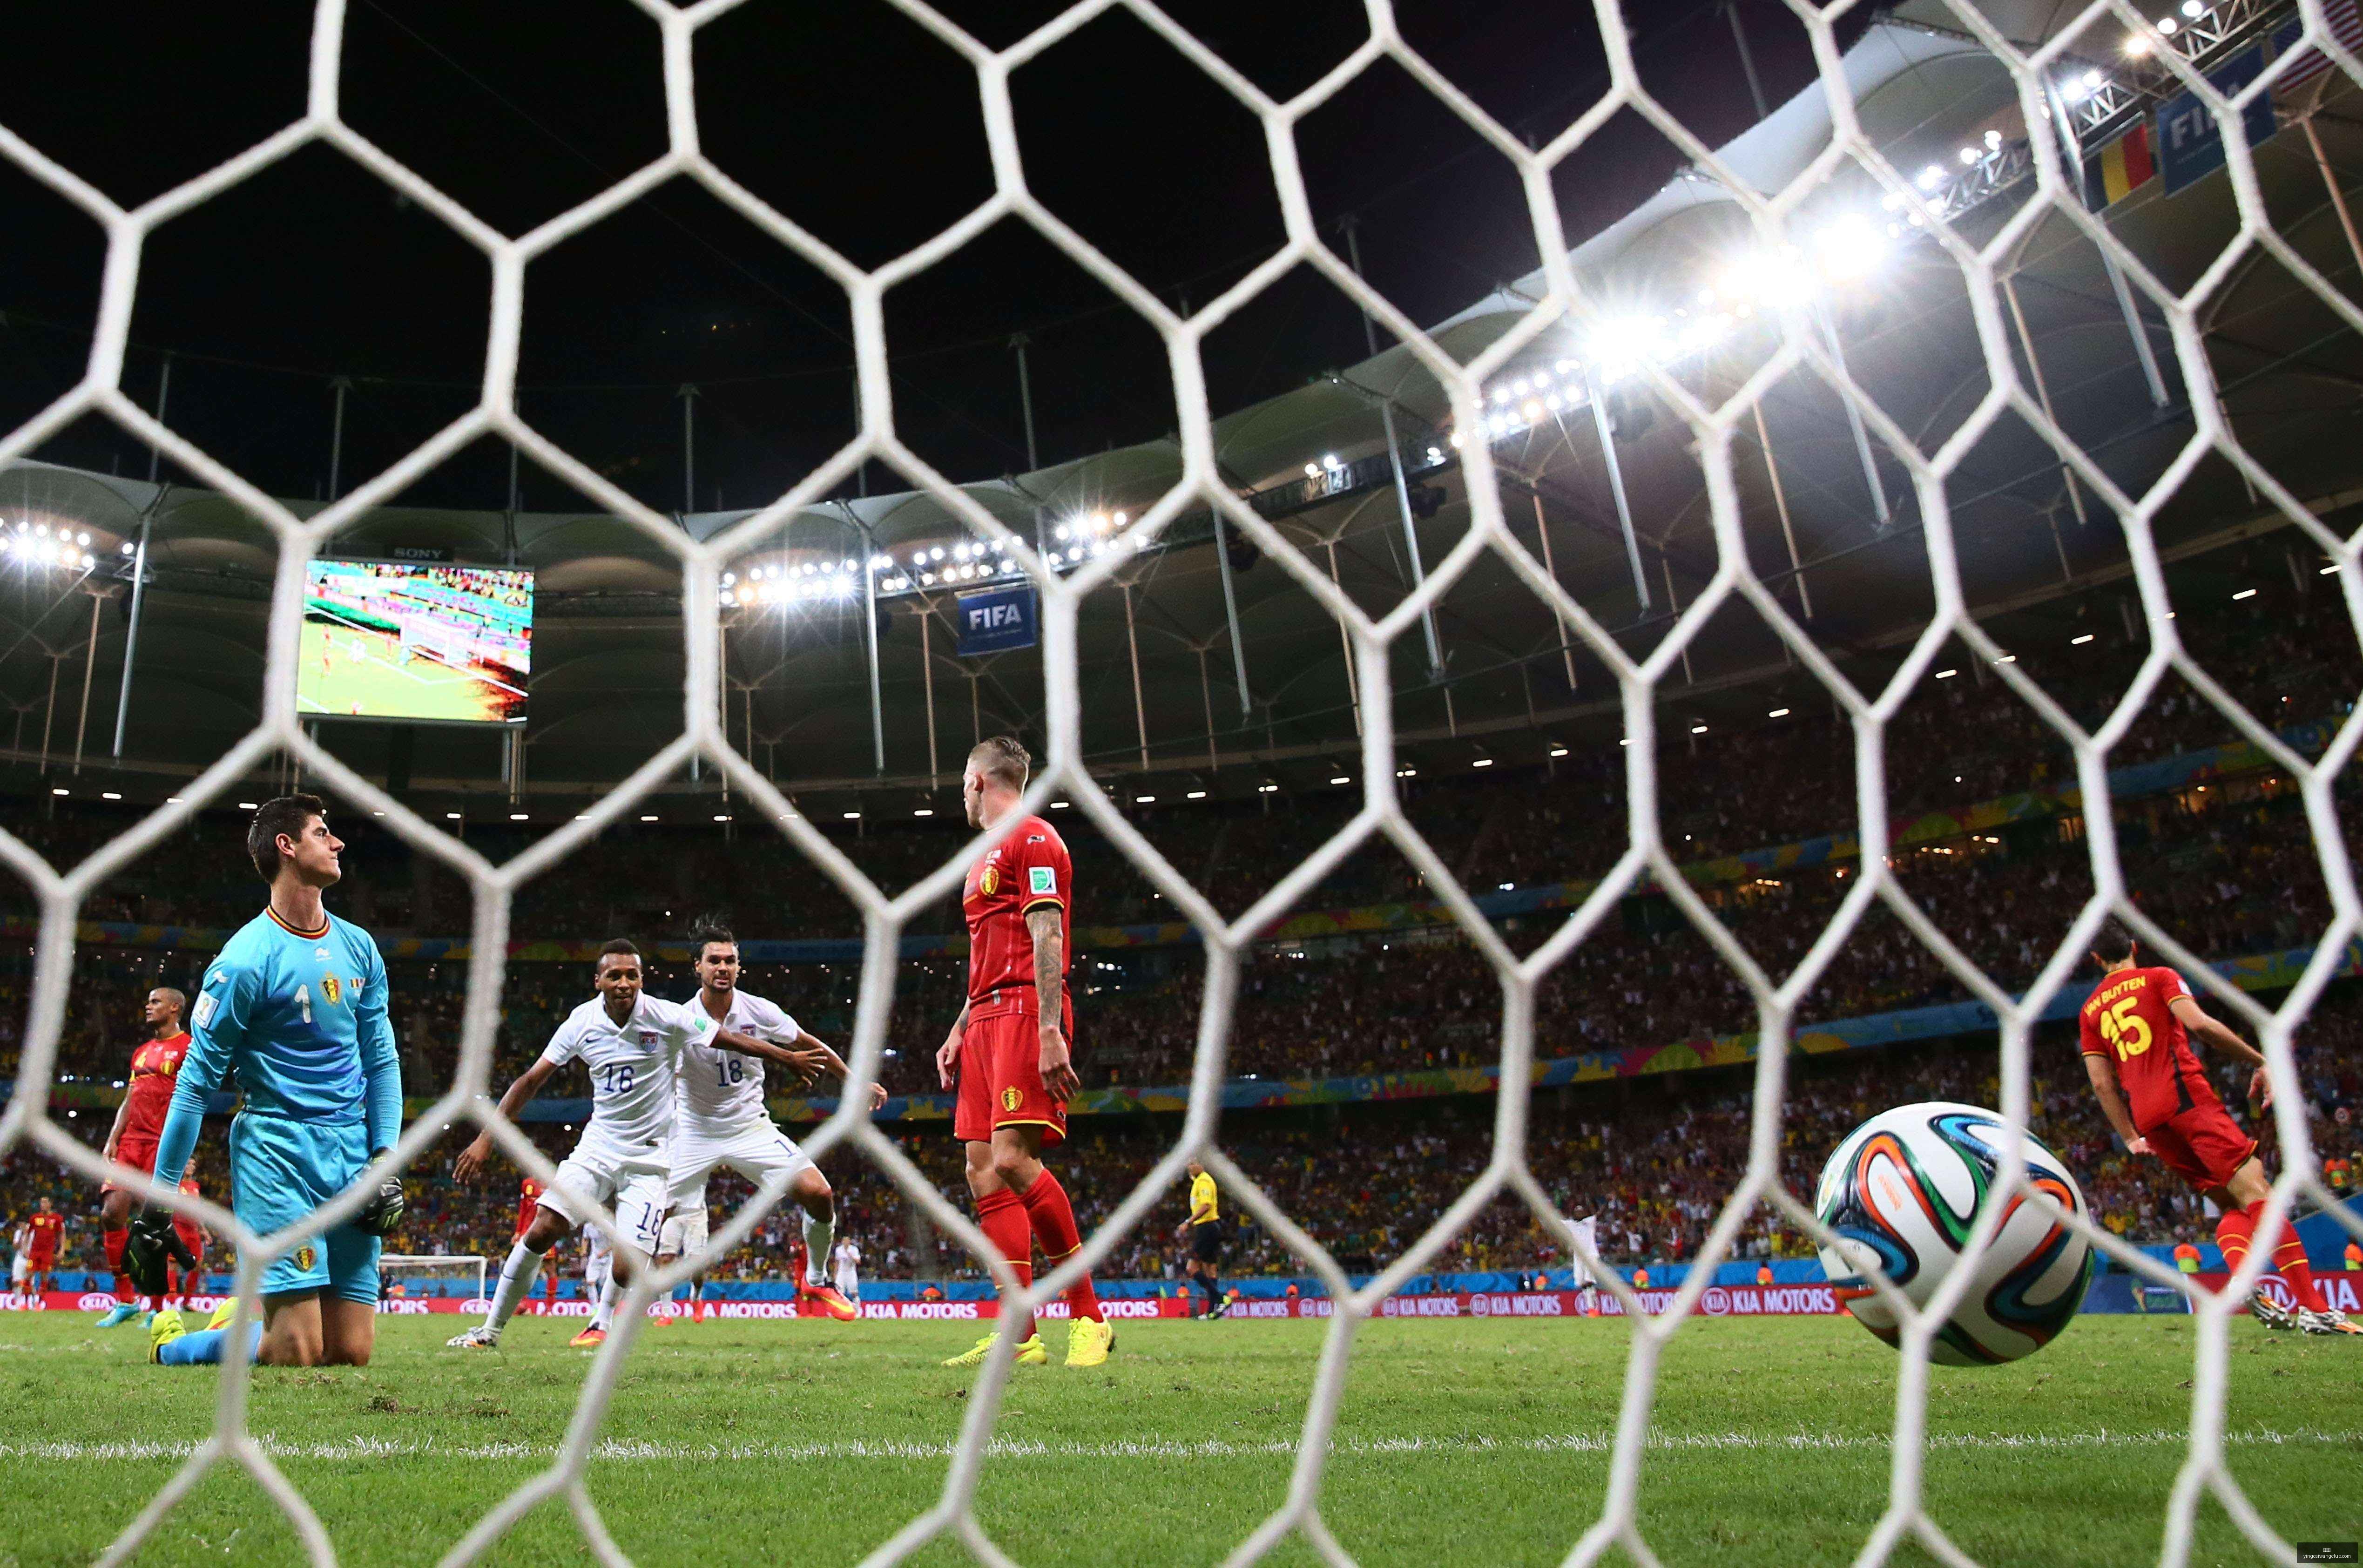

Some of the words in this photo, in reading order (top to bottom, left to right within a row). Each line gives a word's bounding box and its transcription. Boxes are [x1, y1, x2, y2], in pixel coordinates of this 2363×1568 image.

[394, 548, 442, 559] SONY
[969, 604, 1022, 630] FIFA
[2101, 975, 2146, 1004] BUYTEN
[294, 984, 311, 1024] 1
[2100, 996, 2161, 1062] 15
[604, 1063, 635, 1092] 16
[716, 1060, 743, 1087] 18
[1732, 1290, 1762, 1314] KIA
[1763, 1288, 1836, 1314] MOTORS
[2313, 1278, 2360, 1311] IA
[720, 1303, 797, 1318] MOTORS
[865, 1304, 897, 1318] KIA
[901, 1303, 978, 1319] MOTORS
[1097, 1301, 1160, 1317] OTORS
